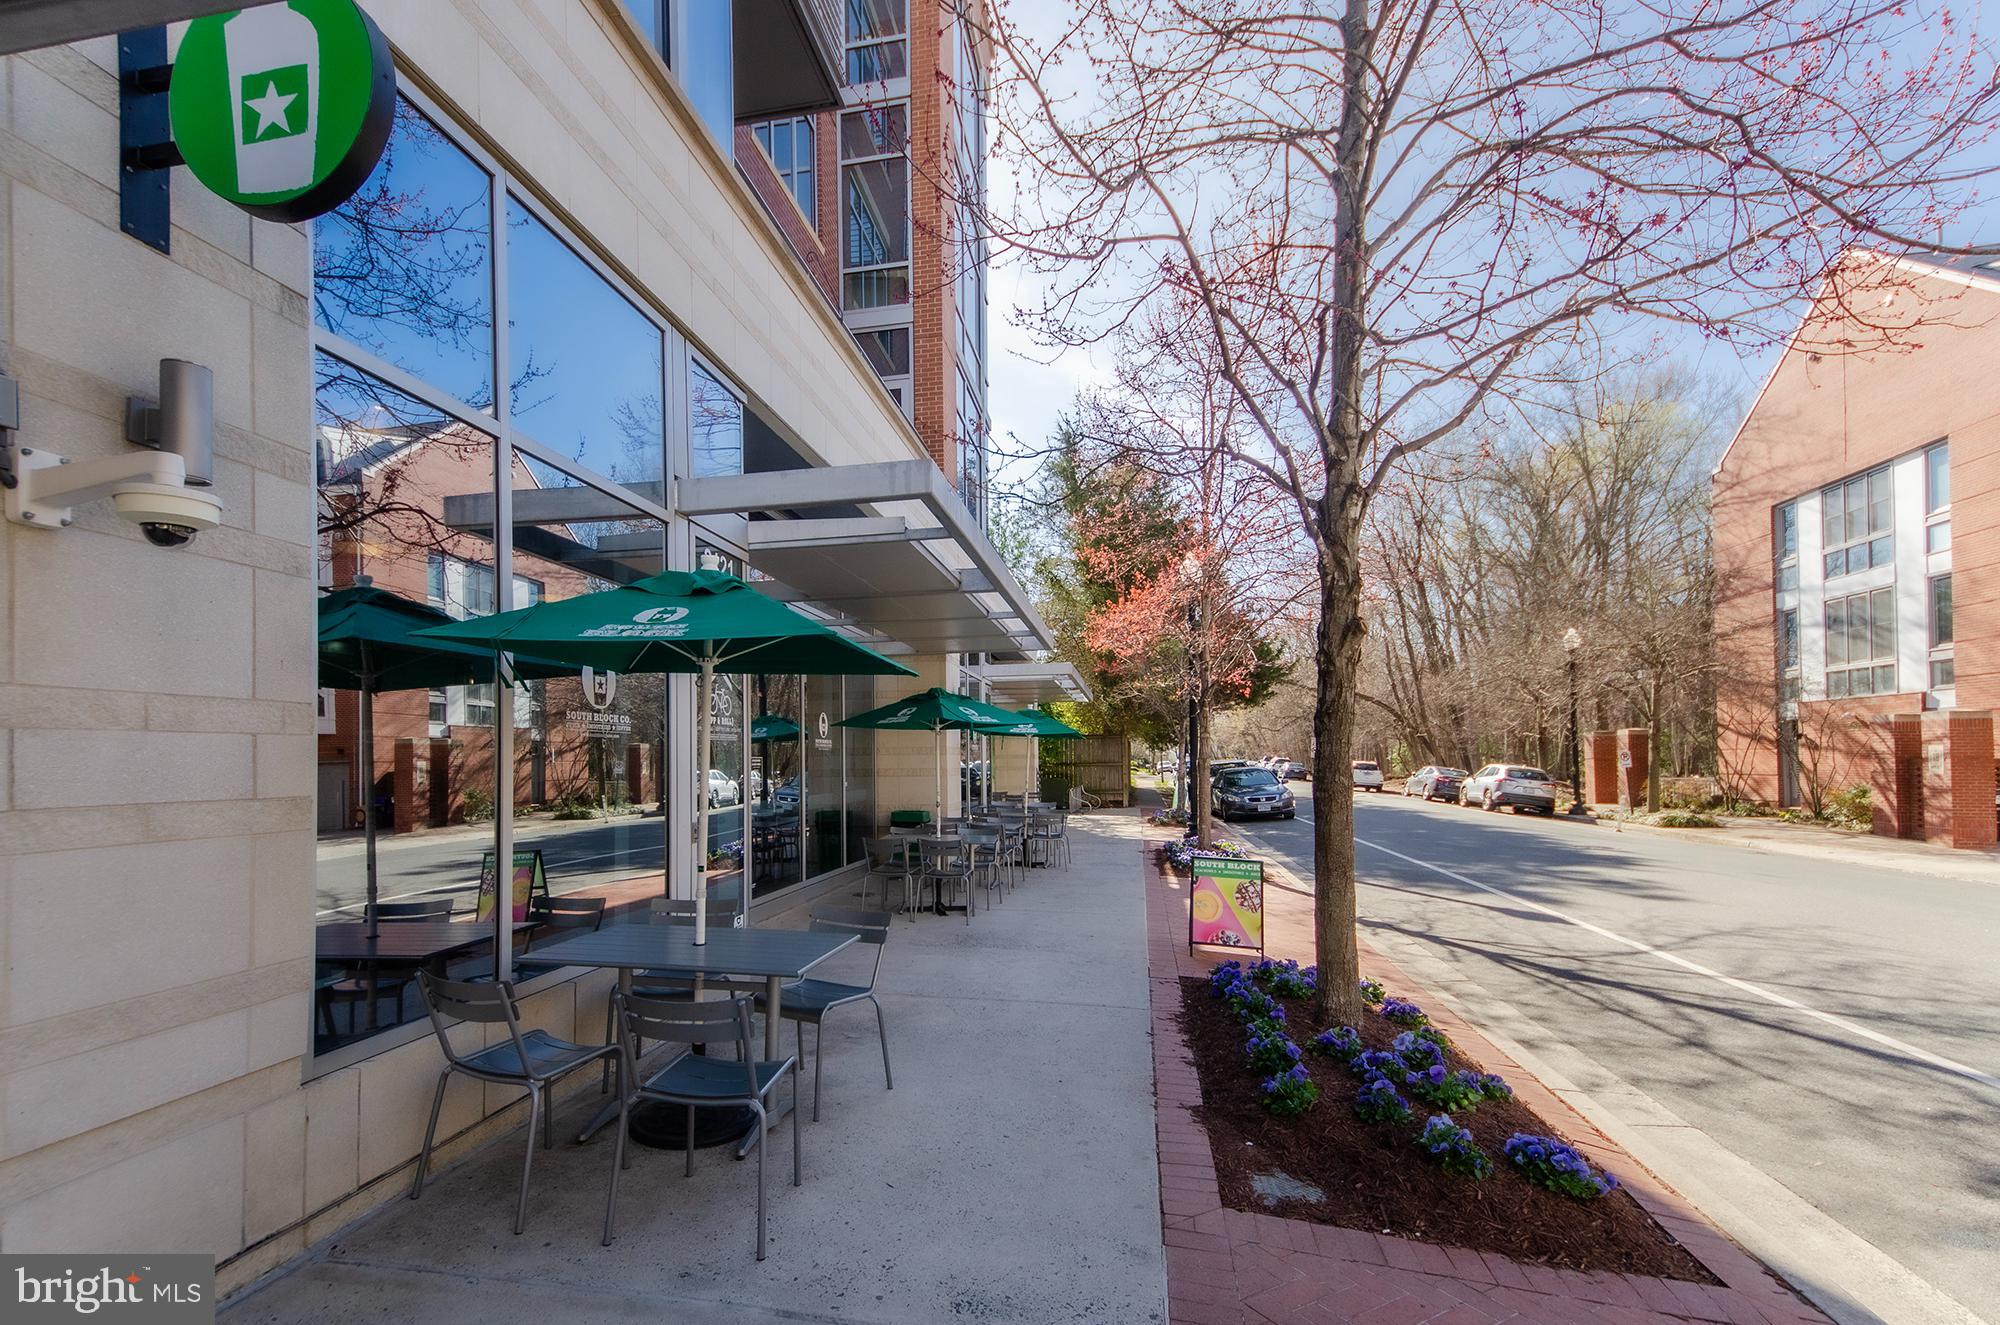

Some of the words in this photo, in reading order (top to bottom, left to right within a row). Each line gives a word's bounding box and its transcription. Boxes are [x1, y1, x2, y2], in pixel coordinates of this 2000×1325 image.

[565, 710, 592, 721] SOUTH
[593, 712, 619, 723] BLOCK
[619, 715, 632, 724] CO.
[1194, 860, 1225, 869] SOUTH
[1227, 863, 1261, 871] BLOCK
